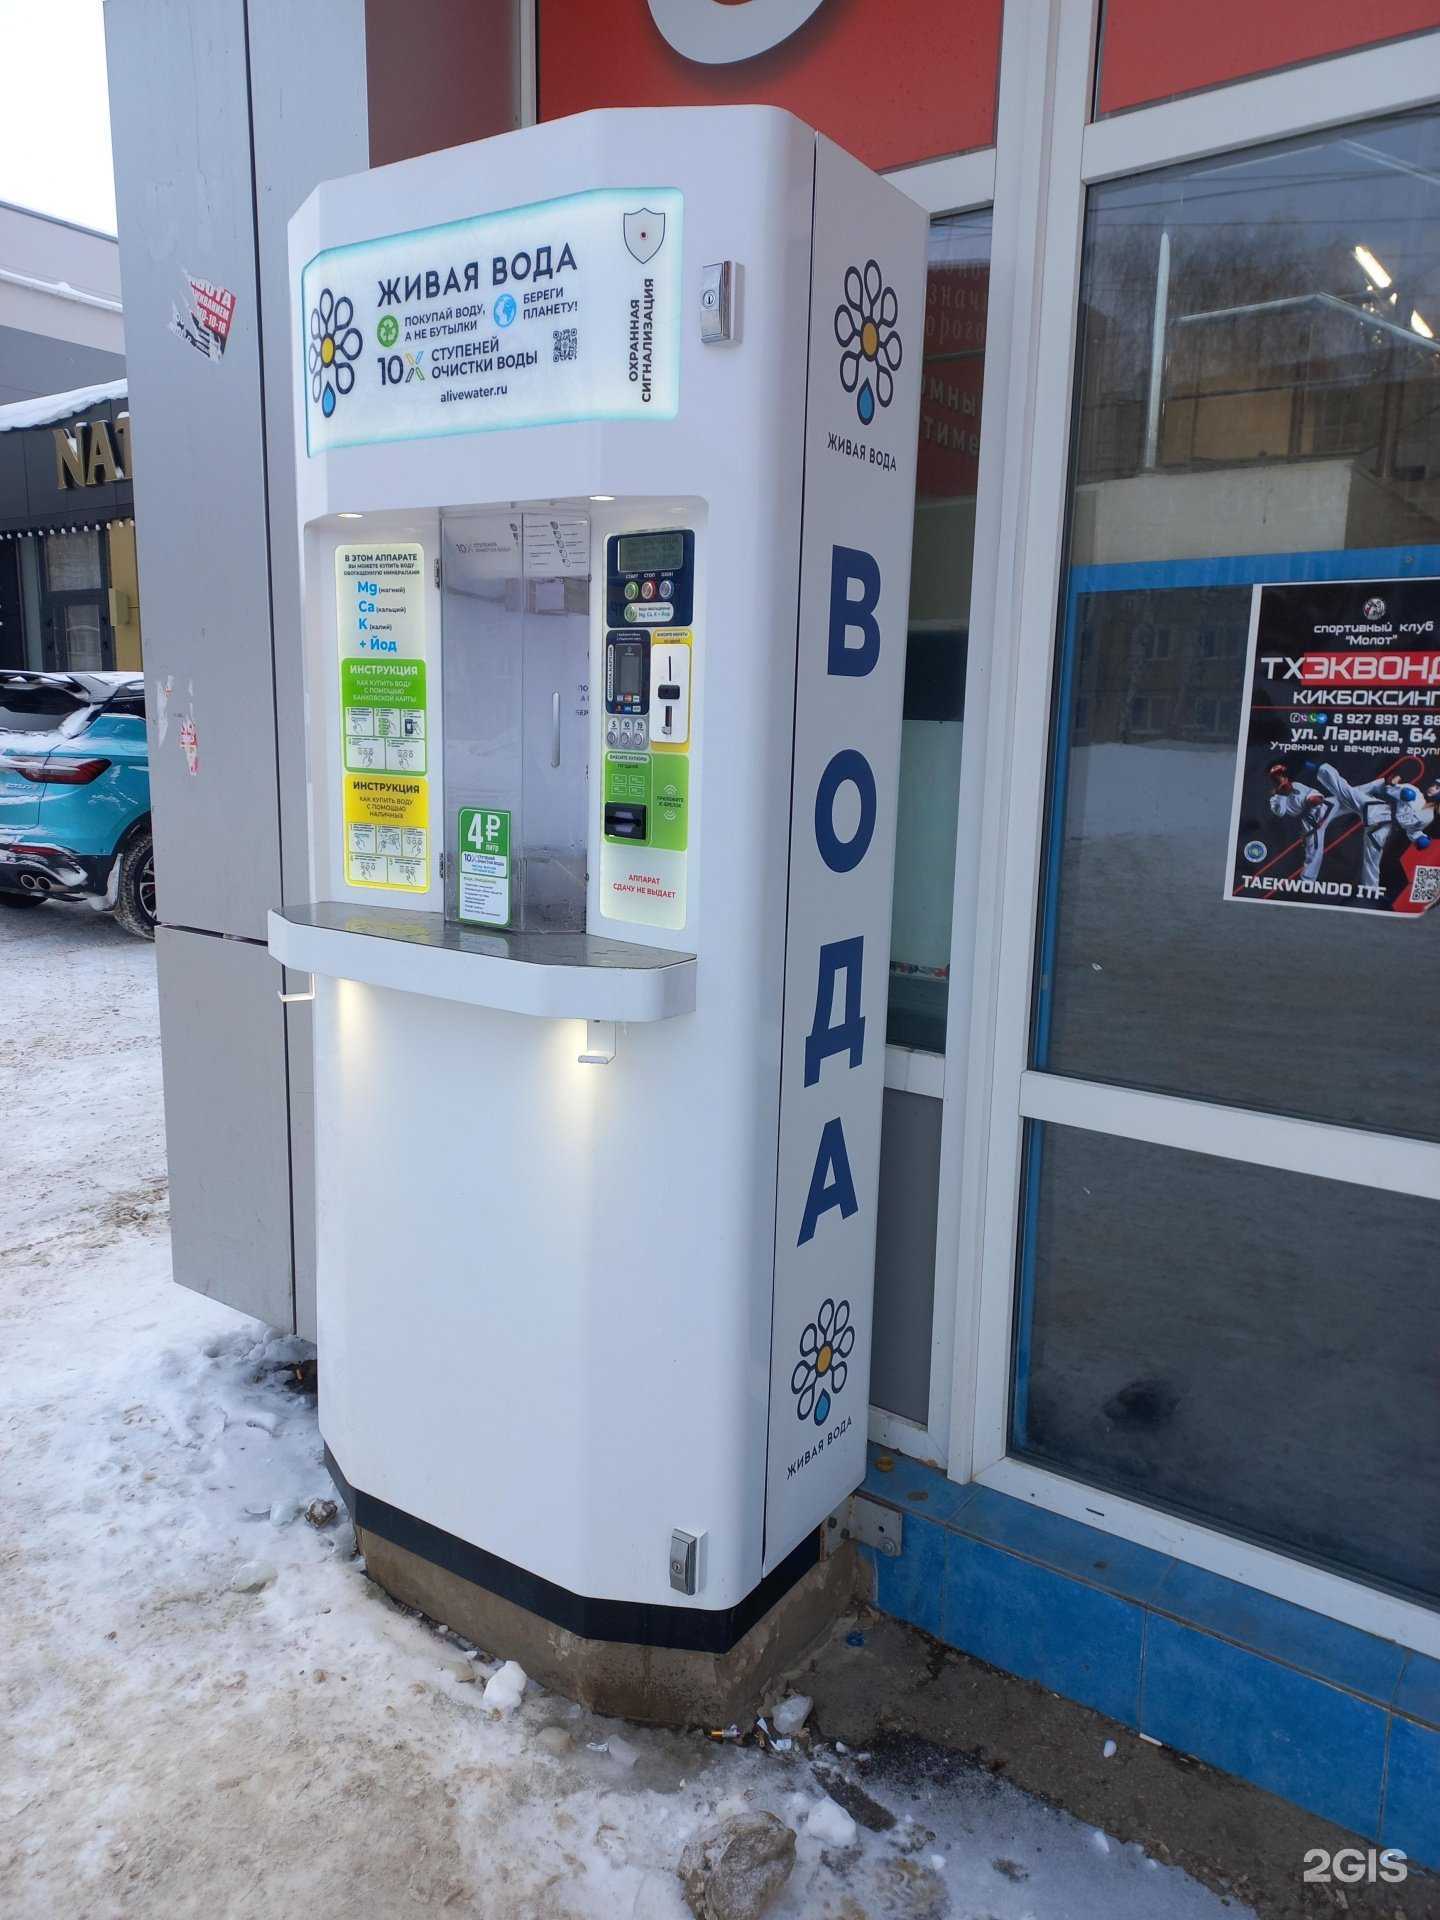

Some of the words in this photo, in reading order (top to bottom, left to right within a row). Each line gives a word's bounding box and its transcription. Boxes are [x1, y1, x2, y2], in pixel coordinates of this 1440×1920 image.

[377, 262, 479, 307] ЖИВАЯ
[492, 242, 577, 286] ВОДА
[523, 287, 564, 304] БЕРЕГИ
[404, 304, 453, 327] ПОКУПАЙ
[455, 302, 486, 319] ВОДУ,
[523, 300, 579, 321] ПЛАНЕТУ!
[404, 329, 413, 342] А
[414, 327, 427, 341] НЕ
[429, 320, 478, 338] БУТЫЛКИ
[431, 335, 499, 362] СТУПЕНЕЙ
[628, 298, 640, 382] ОХРАННАЯ
[641, 278, 655, 403] СИГНАЛИЗАЦИЯ
[431, 357, 494, 380] ОЧИСТКИ
[497, 349, 538, 370] ВОДЫ
[440, 384, 508, 403] alivewater.ru
[827, 431, 866, 464] ЖИВАЯ
[868, 447, 897, 472] ВОДА
[375, 553, 418, 561] АППАРАТЕ
[357, 581, 378, 596] Mg
[358, 600, 375, 613] Ca
[358, 618, 368, 630] K
[1313, 622, 1392, 636] спортивный
[1399, 620, 1434, 634] клуб
[370, 635, 397, 652] Йод
[1345, 634, 1398, 646] "Молот"
[350, 665, 418, 676] ИНСТРУКЦИЯ
[1293, 690, 1440, 706] КИКБОКСИНГ
[1333, 713, 1342, 724] 8
[1346, 713, 1372, 725] 927
[1375, 714, 1399, 725] 891
[1402, 714, 1420, 725] 92
[1290, 727, 1318, 742] ул.
[1323, 725, 1403, 744] Ларина,
[1409, 727, 1436, 743] 64
[1270, 741, 1325, 753] Утренние
[1343, 744, 1400, 756] вечерние
[352, 781, 420, 794] ИНСТРУКЦИЯ
[628, 874, 661, 885] АППАРАТ
[1242, 874, 1353, 897] TAEKWONDO
[1356, 885, 1388, 900] ITF
[613, 882, 635, 893] СДАЧУ
[636, 886, 646, 894] НЕ
[646, 887, 677, 899] ВЫДАЕТ
[796, 543, 882, 1248] ВОДА
[786, 1439, 824, 1480] ЖИВАЯ
[826, 1415, 852, 1446] ВОДА
